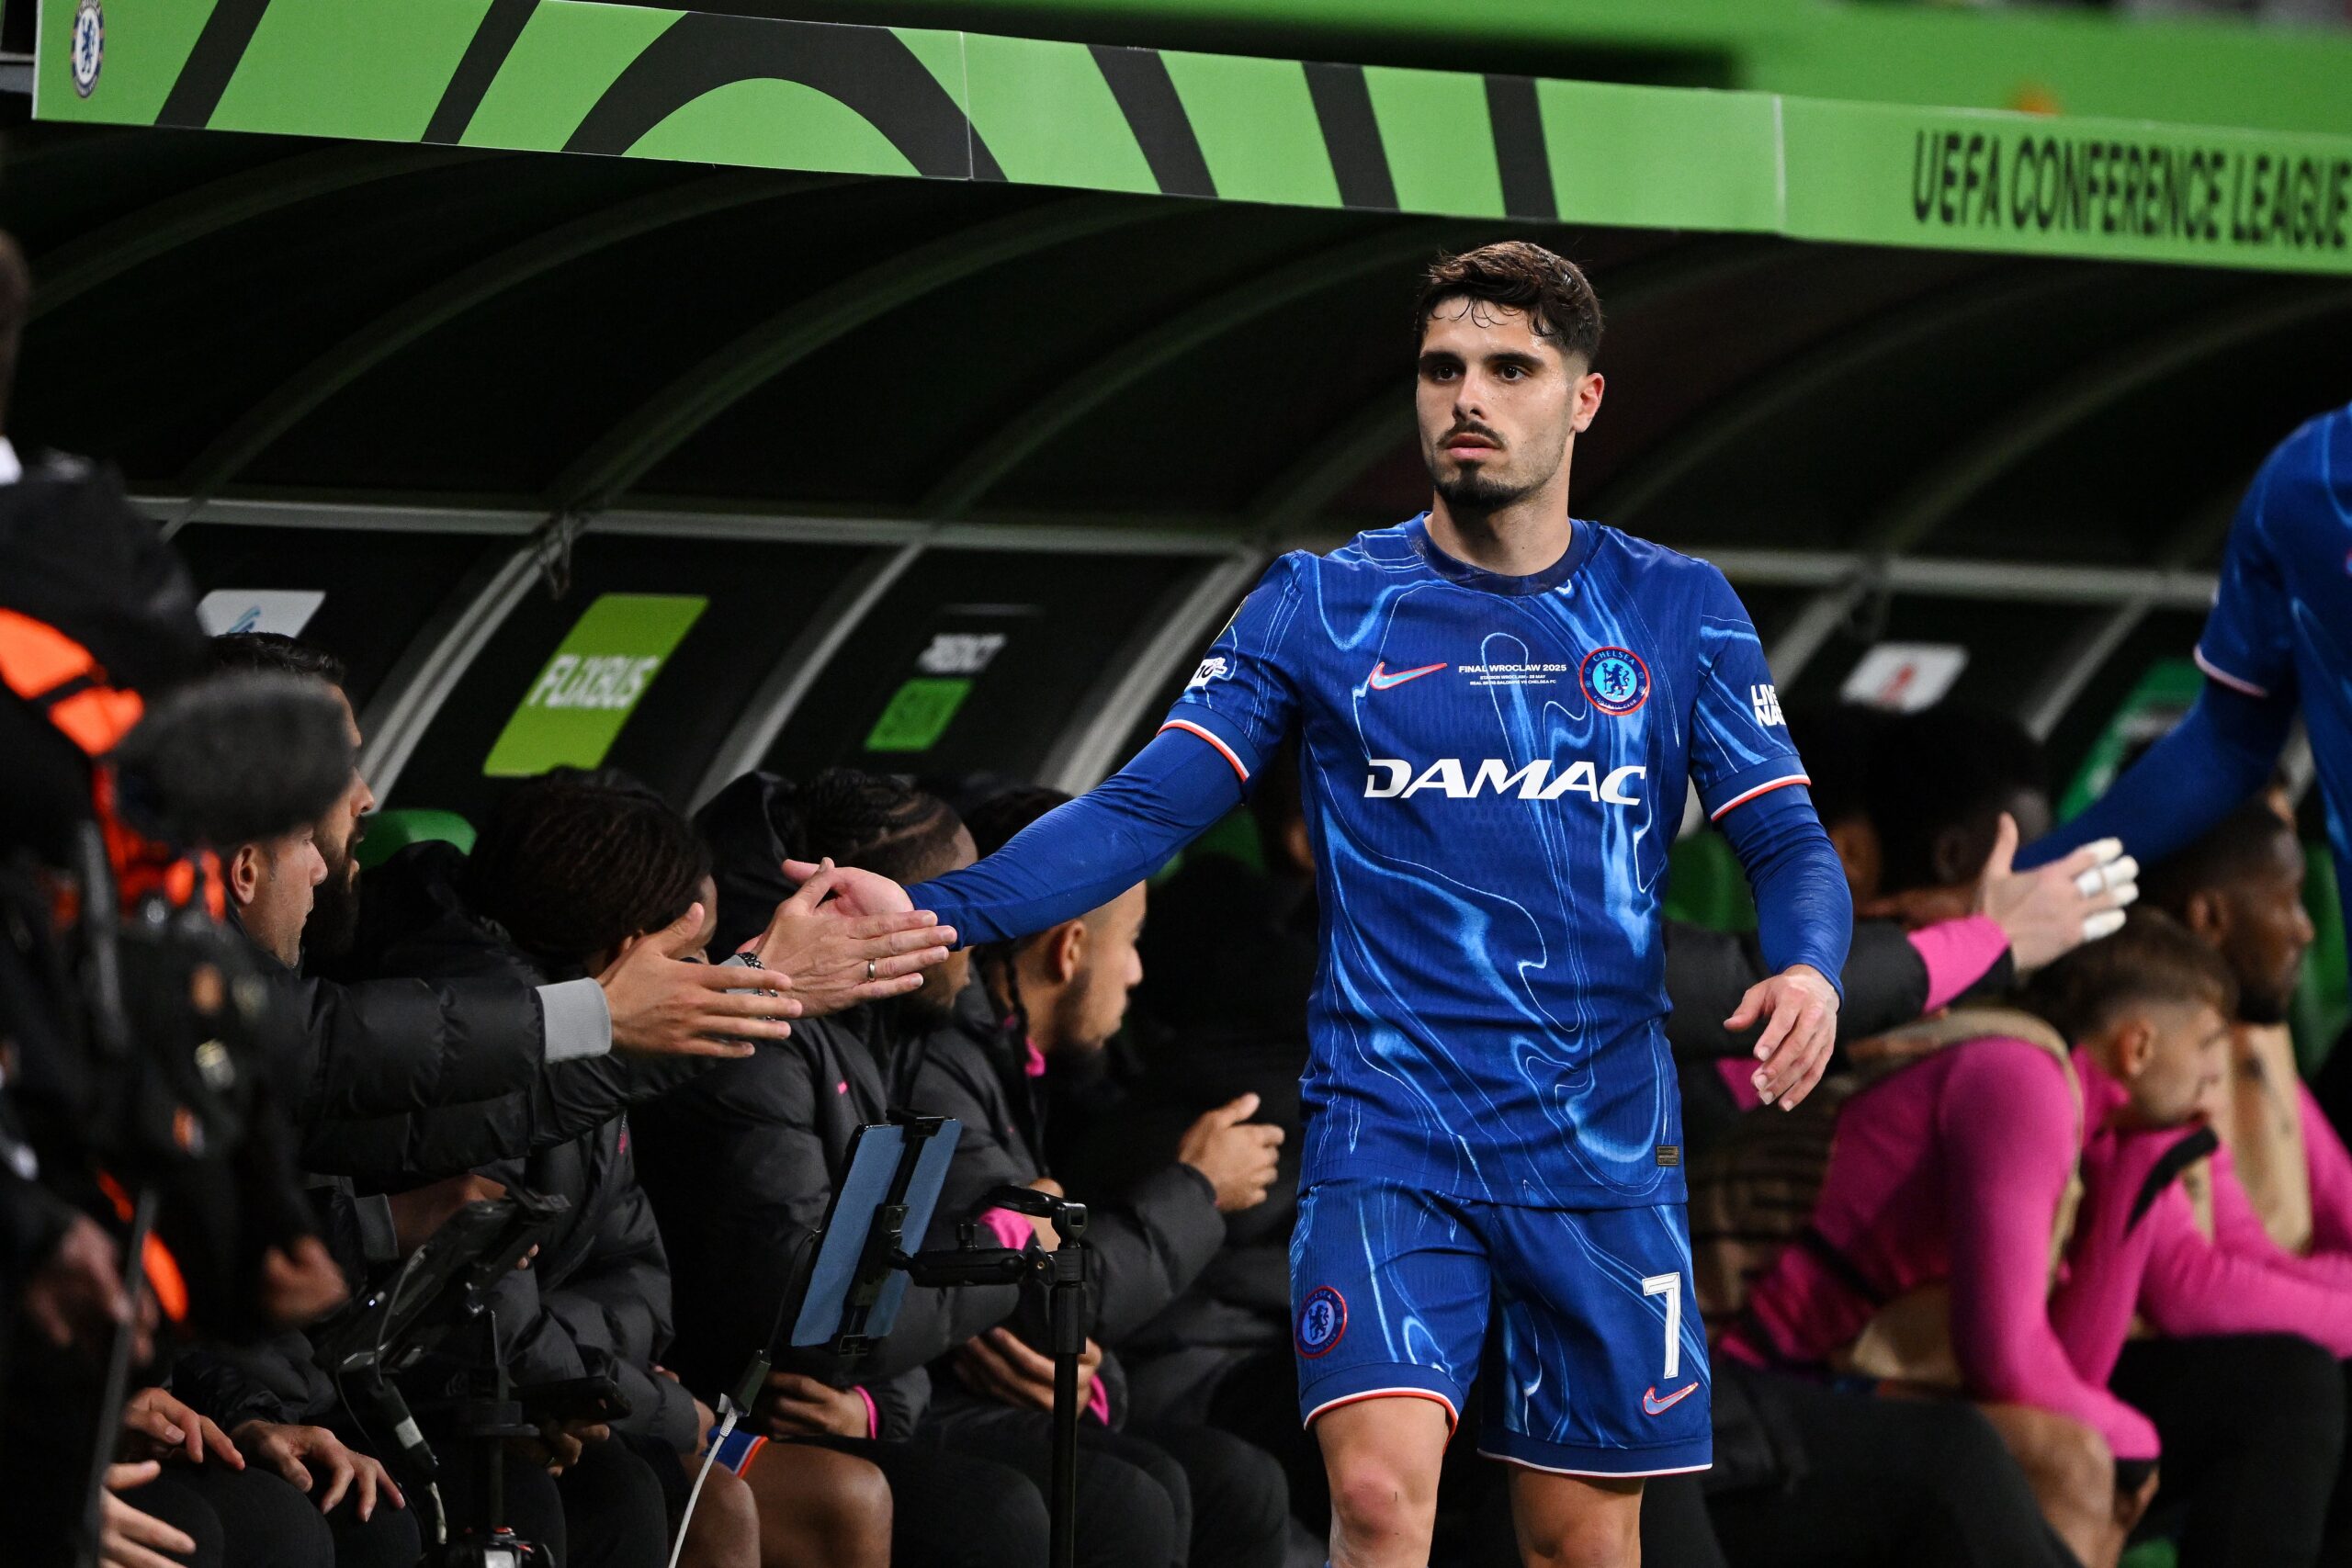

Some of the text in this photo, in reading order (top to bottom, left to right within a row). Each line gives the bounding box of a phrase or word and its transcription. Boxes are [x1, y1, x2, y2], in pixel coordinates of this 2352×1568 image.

[1912, 129, 2352, 250] UEFA CONFERENCE LEAGUE
[1488, 663, 1541, 672] WROCLAW
[1542, 663, 1566, 671] 2025
[1592, 650, 1635, 665] CHELSEA
[1363, 759, 1646, 806] DAMAC
[1642, 1271, 1680, 1379] 7
